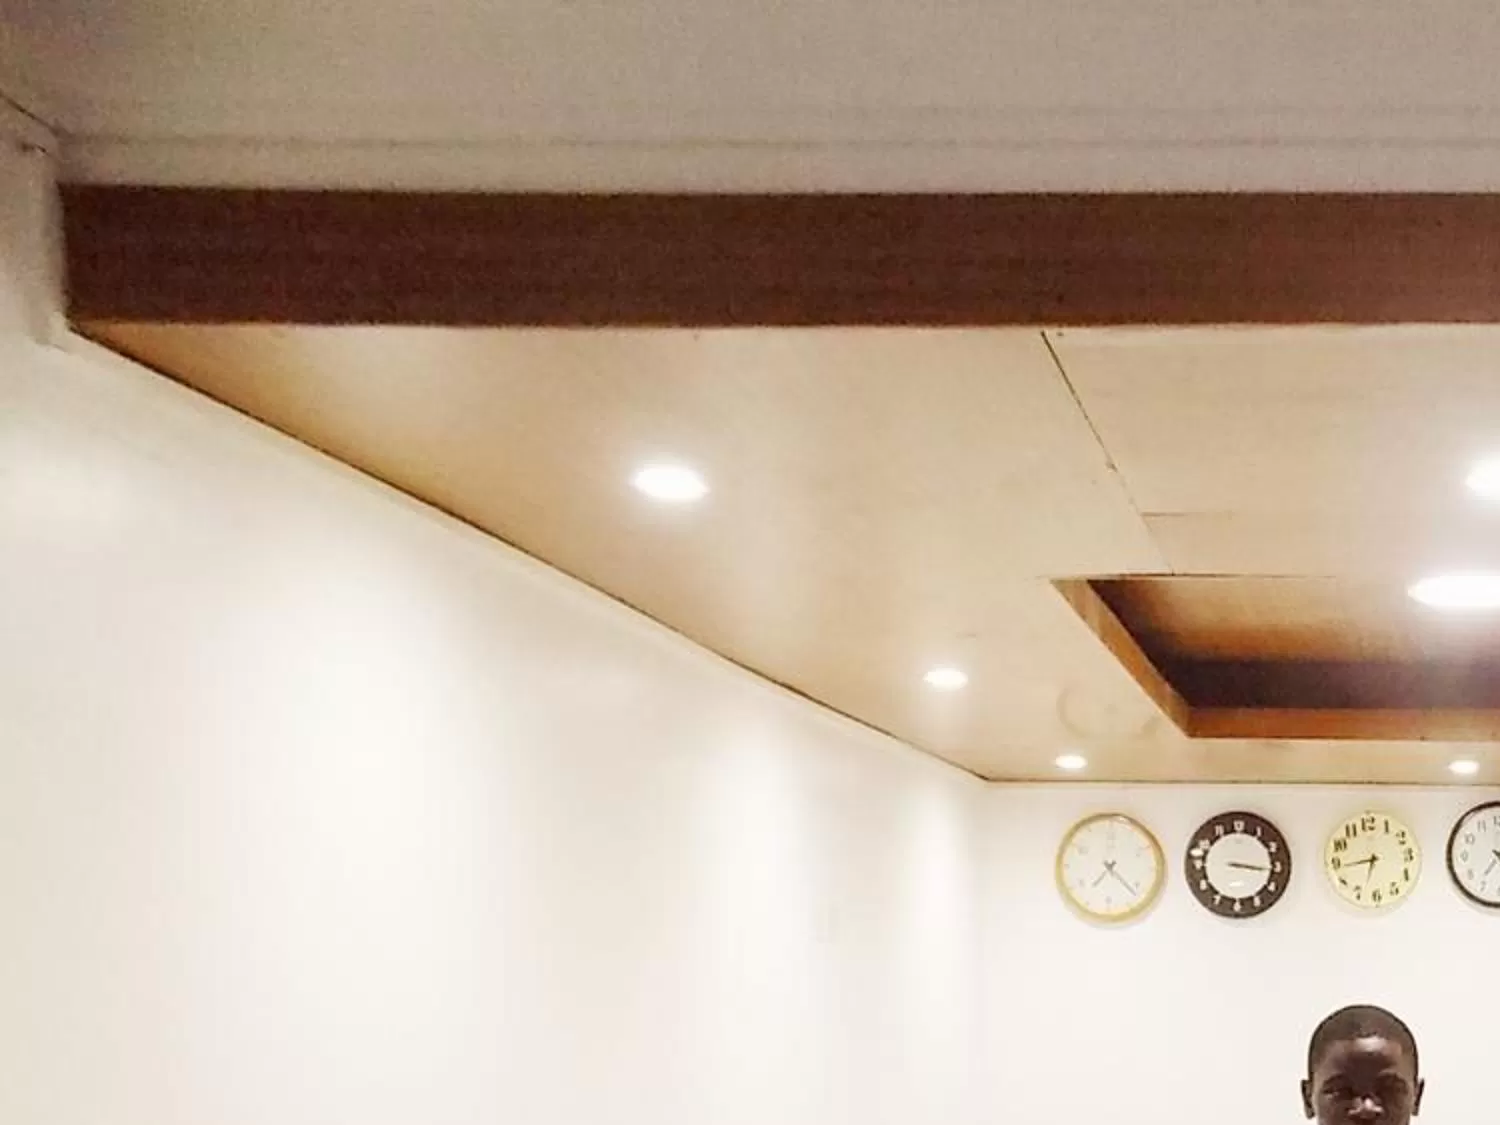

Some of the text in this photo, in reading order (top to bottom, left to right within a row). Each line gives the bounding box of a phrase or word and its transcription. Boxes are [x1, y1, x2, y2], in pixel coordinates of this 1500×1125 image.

[1345, 823, 1357, 838] 11
[1361, 816, 1376, 832] 12
[1383, 819, 1389, 834] 1
[1476, 819, 1487, 832] 11
[1256, 826, 1262, 837] 1
[1395, 831, 1406, 845] 2
[1463, 832, 1476, 845] 10
[1333, 839, 1347, 852] 10
[1403, 847, 1414, 862] 3
[1274, 861, 1282, 873] 3
[1331, 857, 1341, 870] 9
[1353, 885, 1362, 901] 7
[1371, 887, 1382, 902] 6
[1389, 881, 1400, 896] 5
